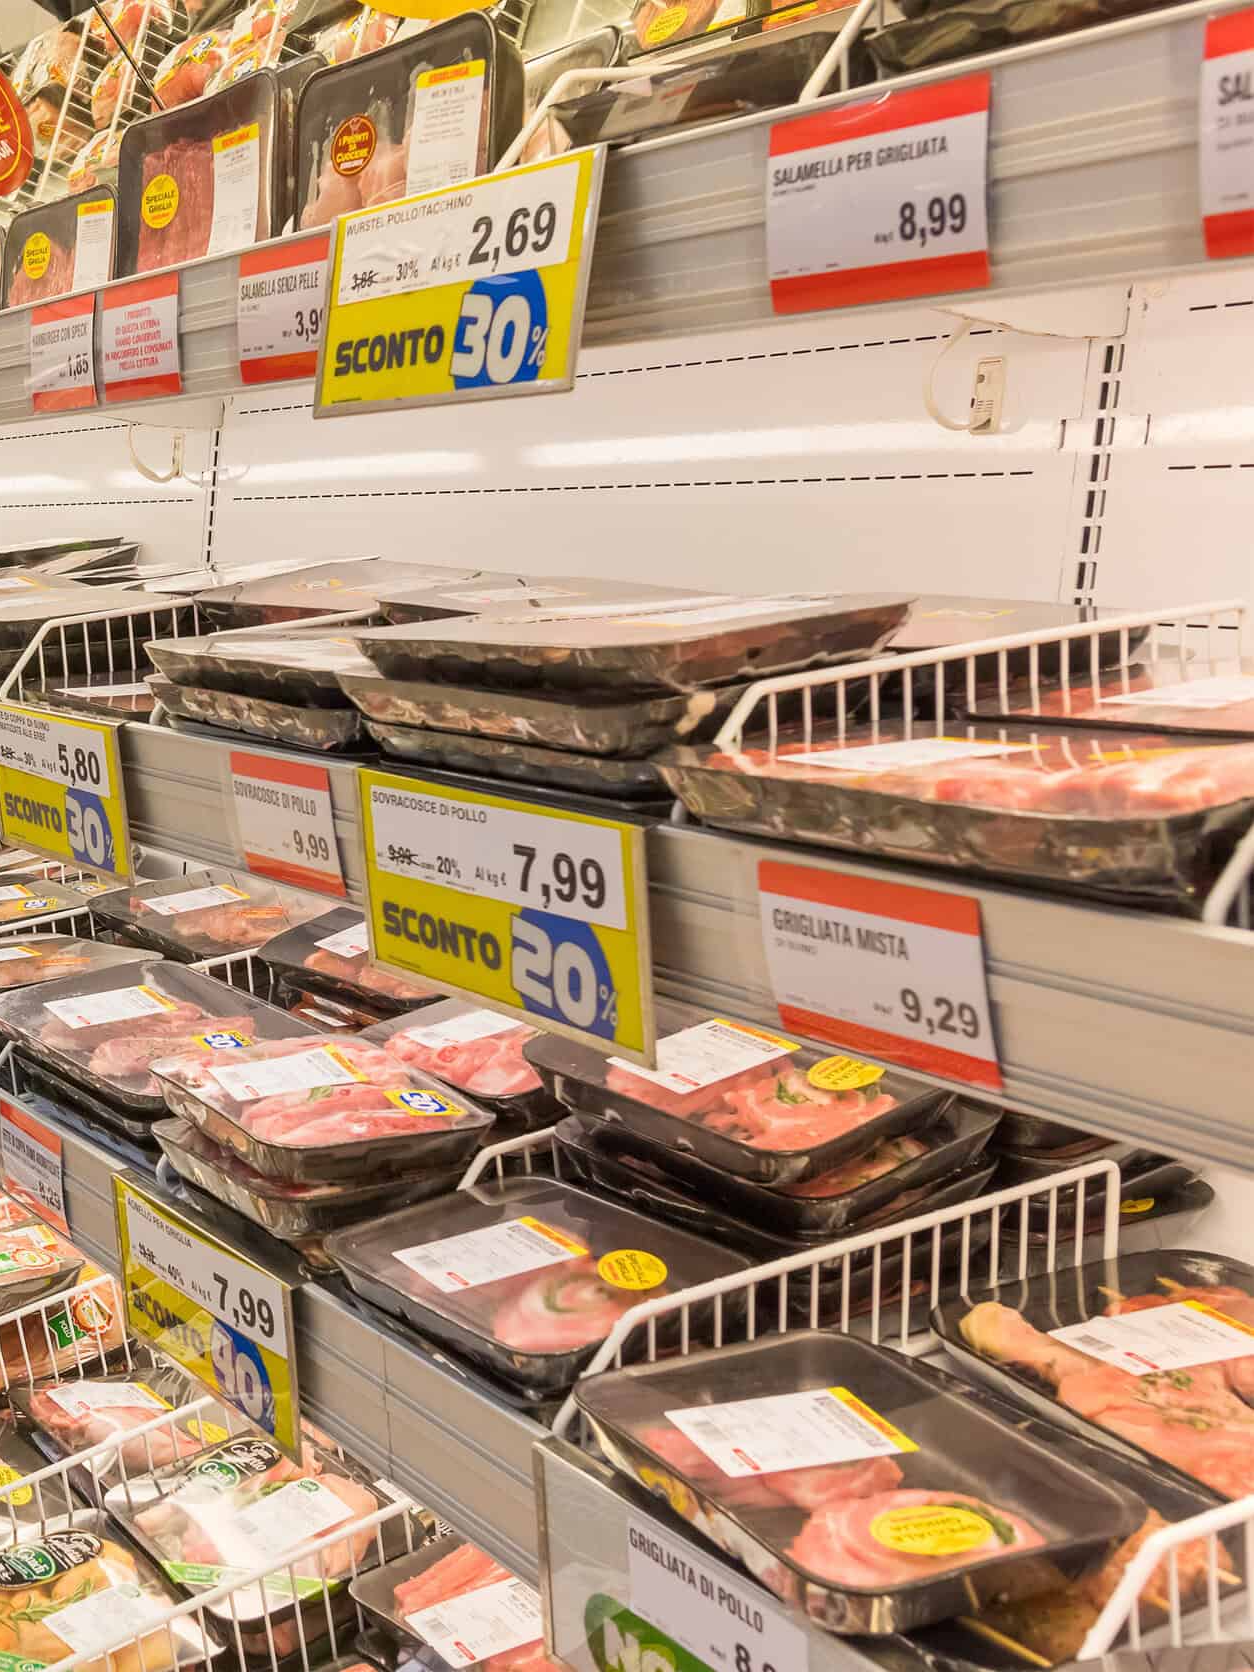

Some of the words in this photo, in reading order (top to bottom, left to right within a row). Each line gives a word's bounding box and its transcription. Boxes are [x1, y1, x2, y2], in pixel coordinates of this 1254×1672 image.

[773, 157, 843, 187] SALAMELLA
[846, 150, 873, 172] PER
[876, 136, 949, 167] GRIGLIATA
[145, 190, 175, 205] SPECIALE
[899, 193, 966, 248] 8,99
[468, 201, 557, 273] 2,69
[241, 279, 275, 301] SALAMELLA
[277, 276, 297, 295] SENZA
[298, 270, 319, 289] PELLE
[67, 352, 89, 379] 1,85
[334, 325, 444, 377] SCONTO
[58, 744, 100, 787] 5,80
[4, 792, 62, 833] SCONTO
[234, 780, 280, 807] SOVRACOSCE
[282, 793, 290, 808] DI
[291, 795, 316, 816] POLLO
[373, 791, 437, 814] SOVRACOSCE
[439, 803, 449, 816] DI
[452, 806, 487, 823] POLLO
[293, 830, 329, 861] 9,99
[436, 855, 461, 879] 20%
[513, 843, 606, 910] 7,99
[383, 900, 501, 970] SCONTO
[773, 908, 852, 947] GRIGLIATA
[856, 927, 910, 961] MISTA
[900, 987, 980, 1039] 9,29
[213, 1272, 275, 1338] 7,99
[629, 1527, 696, 1587] GRIGLIATA
[700, 1576, 715, 1601] DI
[718, 1588, 763, 1634] POLLO
